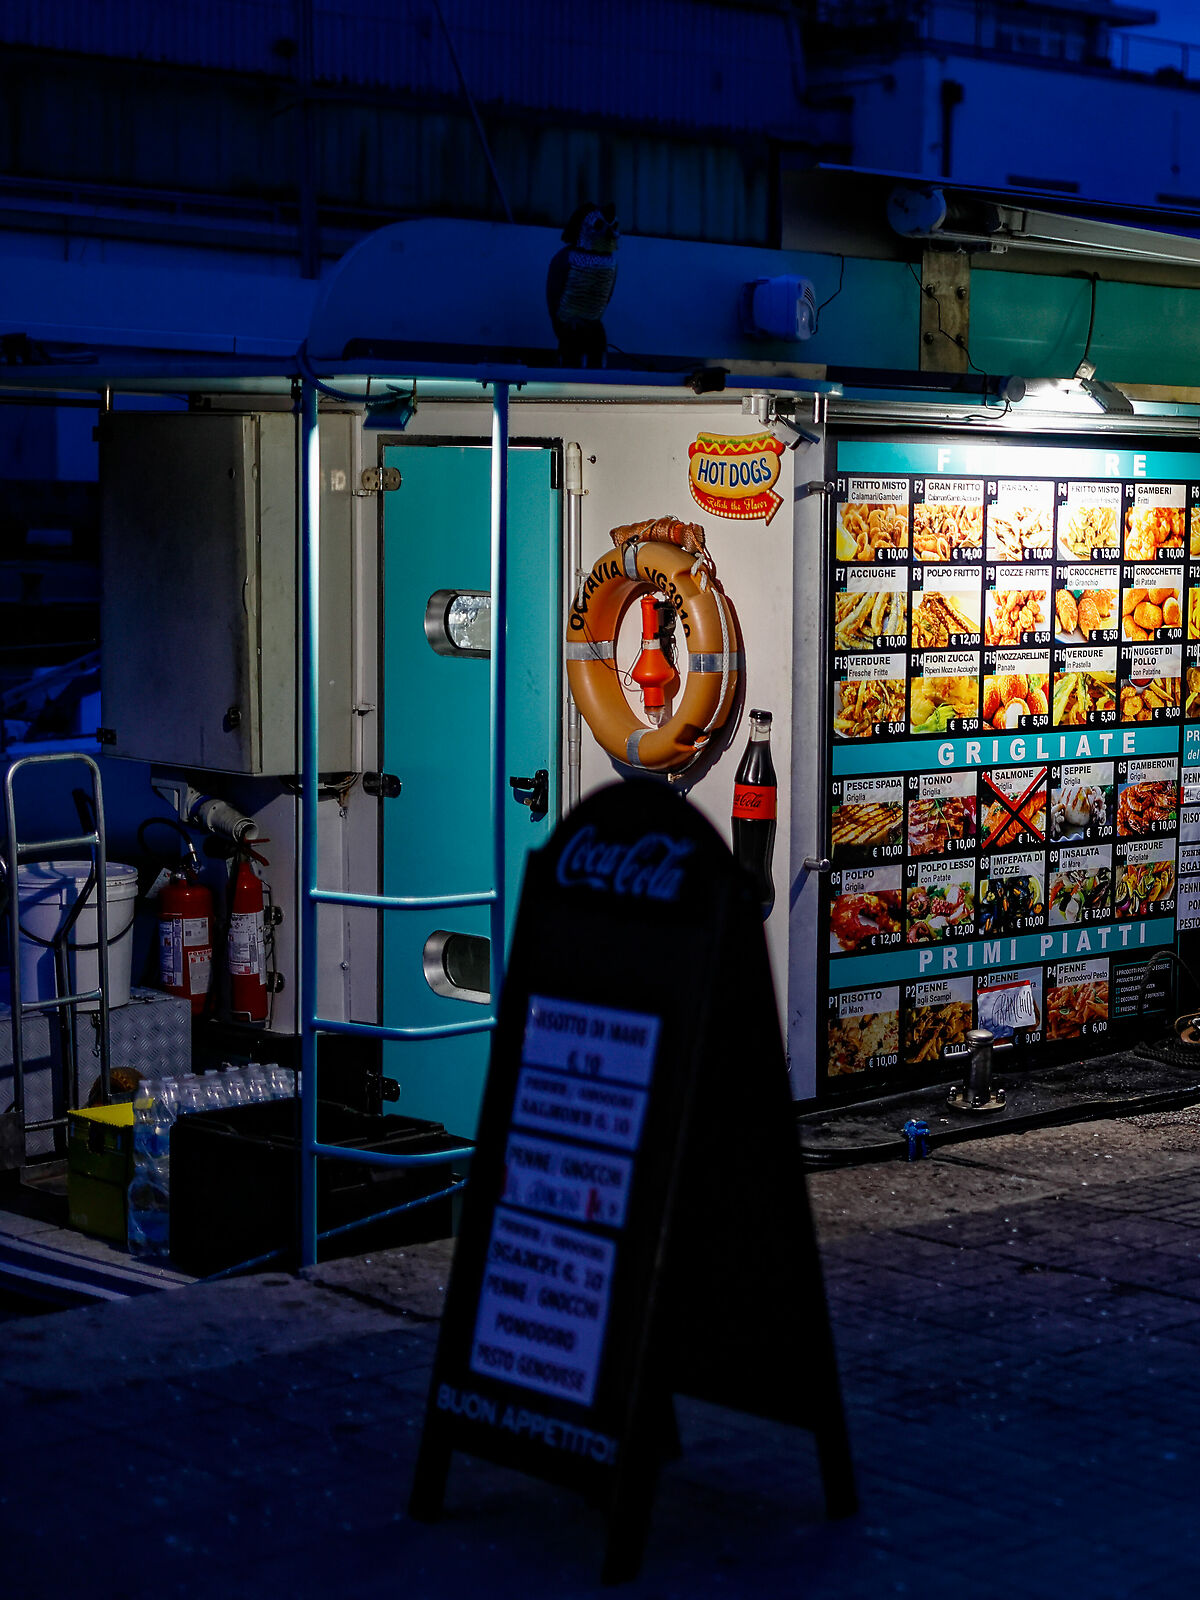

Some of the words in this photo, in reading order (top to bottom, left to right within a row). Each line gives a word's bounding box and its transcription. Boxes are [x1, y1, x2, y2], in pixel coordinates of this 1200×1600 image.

[698, 458, 727, 486] HOT
[729, 457, 772, 487] DOGS
[852, 481, 880, 490] FRITTO
[882, 482, 907, 491] MISTO
[929, 482, 951, 491] GRAN
[953, 482, 980, 491] FRITTO
[1072, 485, 1096, 494] FRITTO
[1098, 486, 1120, 495] MISTO
[1138, 487, 1172, 496] GAMBERI
[706, 497, 728, 510] Relish
[730, 501, 741, 510] the
[886, 549, 908, 561] 10,00
[1164, 548, 1184, 560] 10,00
[836, 568, 845, 580] F7
[850, 569, 896, 579] ACCIUGHE
[927, 569, 951, 578] POLPO
[953, 568, 980, 577] FRITTO
[1000, 568, 1023, 577] COZZE
[1025, 568, 1050, 576] FRITTE
[1070, 567, 1118, 576] CROCCHETTE
[1136, 567, 1182, 576] CROCCHETTE
[570, 560, 624, 631] OCTAVIA
[960, 634, 980, 646] 12,00
[1167, 628, 1182, 640] 4,00
[885, 636, 907, 649] 10,00
[1067, 649, 1103, 658] VERDURE
[1133, 647, 1164, 656] NUGGET
[1165, 647, 1173, 655] DI
[834, 656, 848, 668] F13
[849, 656, 891, 665] VERDURE
[925, 654, 946, 663] FIORI
[947, 654, 974, 663] ZUCCA
[1133, 657, 1157, 666] POLLO
[849, 669, 871, 677] Fresche
[873, 668, 888, 676] Fritte
[1100, 712, 1116, 723] 5,50
[1165, 707, 1181, 719] 8,00
[962, 719, 979, 731] 5,50
[1032, 715, 1049, 726] 5,50
[888, 722, 905, 734] 5,00
[937, 732, 1137, 766] GRIGLIATE
[1188, 749, 1199, 758] del
[1064, 766, 1091, 776] SEPPIE
[1130, 760, 1174, 771] GAMBERONI
[922, 775, 952, 785] TONNO
[995, 770, 1034, 781] SALMONE
[832, 782, 841, 795] G1
[846, 780, 874, 791] PESCE
[875, 778, 902, 789] SPADA
[908, 776, 919, 789] G2
[846, 792, 866, 802] Griglia
[922, 787, 941, 797] Griglia
[1097, 826, 1112, 837] 7,00
[1158, 820, 1176, 832] 10,00
[955, 838, 976, 850] 10,00
[1128, 841, 1164, 852] VERDURE
[881, 844, 903, 857] 10,00
[1062, 847, 1099, 858] INSALATA
[558, 825, 693, 899] Coca-Cola
[920, 862, 948, 873] POLPO
[949, 859, 974, 871] LESSO
[993, 855, 1033, 867] IMPEPATA
[1034, 853, 1043, 862] DI
[845, 869, 875, 880] POLPO
[993, 866, 1020, 876] COZZE
[920, 876, 932, 884] con
[932, 873, 951, 882] Patate
[844, 882, 865, 892] Griglia
[1160, 901, 1175, 912] 5,50
[1091, 907, 1111, 920] 12,00
[1024, 915, 1044, 928] 10,00
[953, 923, 974, 936] 12,00
[880, 932, 901, 946] 12,00
[919, 938, 1017, 973] PRIMI
[1040, 922, 1146, 957] PIATTI
[1046, 965, 1057, 978] P4
[1058, 963, 1087, 975] PENNE
[977, 974, 989, 986] P3
[989, 972, 1019, 984] PENNE
[905, 984, 916, 997] P2
[917, 982, 948, 994] PENNE
[828, 995, 838, 1008] P1
[841, 991, 883, 1006] RISOTTO
[1092, 1020, 1108, 1032] 6,00
[1025, 1030, 1040, 1044] 9,00
[875, 1054, 897, 1068] 10,00
[435, 1380, 499, 1426] BUON
